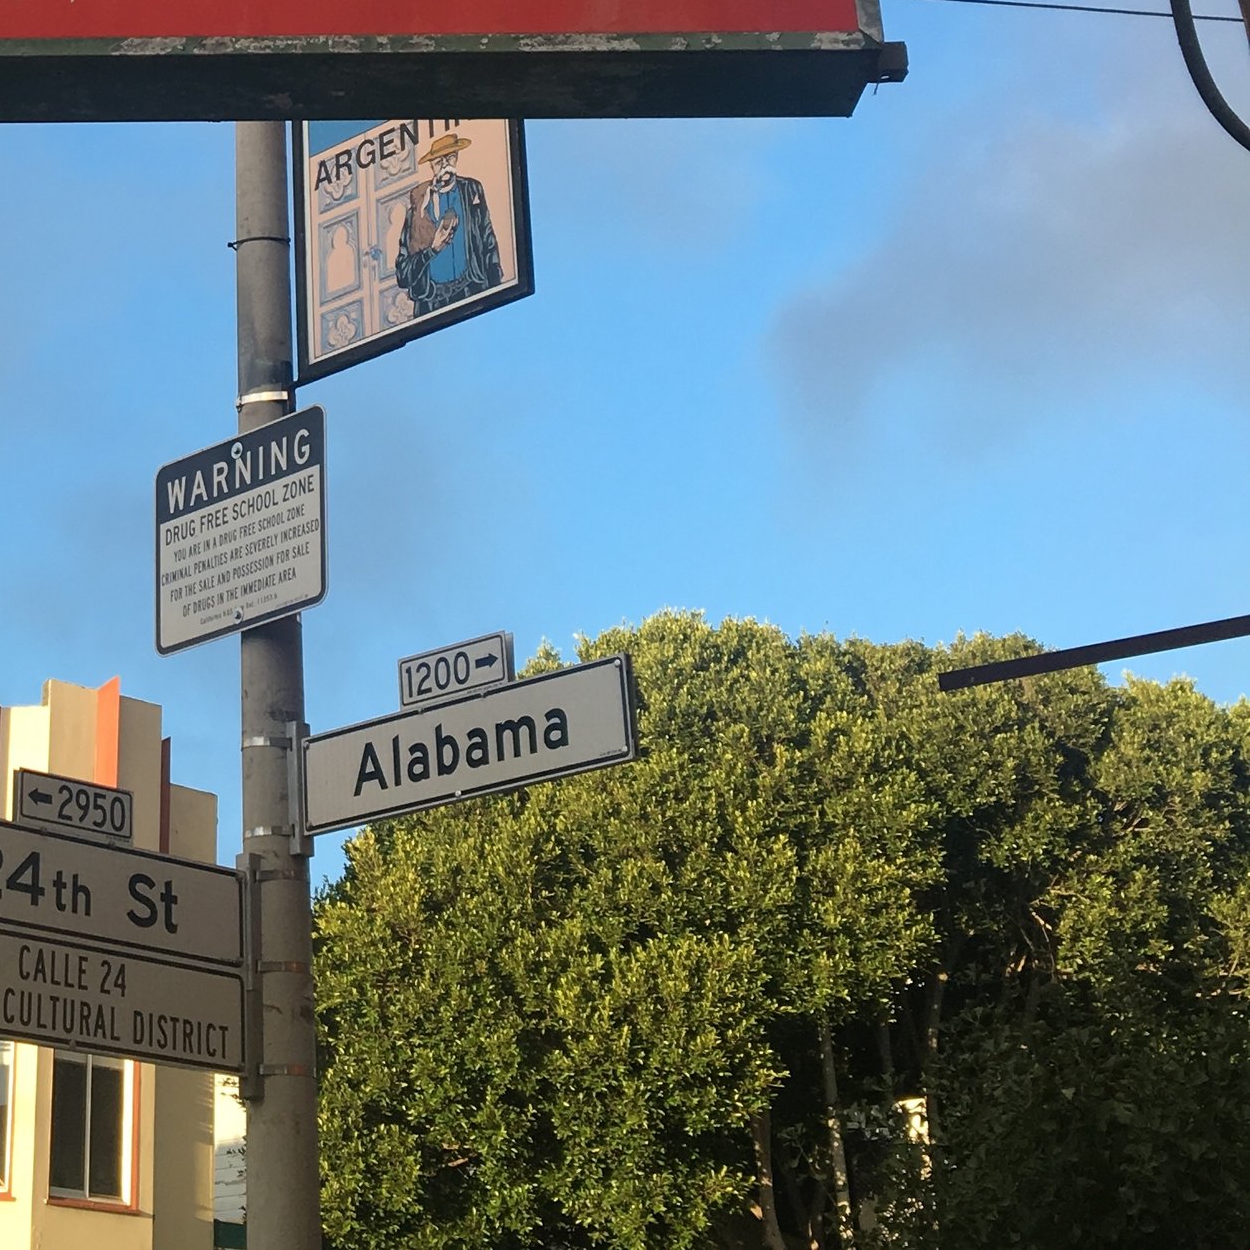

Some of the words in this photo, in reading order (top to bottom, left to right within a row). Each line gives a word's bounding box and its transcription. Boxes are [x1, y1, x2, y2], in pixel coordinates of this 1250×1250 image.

[167, 428, 311, 514] WARNING
[165, 519, 196, 546] DRUG
[200, 506, 229, 533] FREE
[232, 488, 279, 521] SCHOOL
[282, 474, 314, 502] ZONE
[173, 549, 187, 563] YOU
[188, 543, 201, 558] ARE
[203, 539, 211, 552] IN
[219, 530, 237, 546] DRUG
[239, 524, 256, 540] FREE
[258, 514, 285, 535] SCHOOL
[287, 504, 305, 521] ZONE
[161, 567, 192, 587] CRIMINAL
[194, 552, 228, 578] PENALTIES
[230, 546, 243, 562] ARE
[245, 533, 279, 556] SEVERELY
[280, 518, 319, 542] INCREASED
[170, 589, 183, 603] FOR
[184, 582, 197, 597] THE
[199, 574, 215, 592] SALE
[217, 569, 231, 585] AND
[233, 555, 274, 580] POSSESSION
[276, 549, 290, 565] FOR
[292, 541, 310, 559] SALE
[182, 604, 191, 618] OF
[193, 596, 216, 614] DRUGS
[226, 587, 239, 602] THE
[240, 573, 277, 597] IMMEDIATE
[278, 566, 297, 583] AREA
[405, 651, 471, 698] 1200
[353, 707, 569, 797] Alabama
[57, 784, 126, 832] 2950
[126, 872, 179, 934] St
[18, 944, 89, 991] CALLE
[99, 959, 127, 997] 24
[3, 986, 121, 1042] CULTURAL
[132, 1009, 230, 1060] DISTRICT
